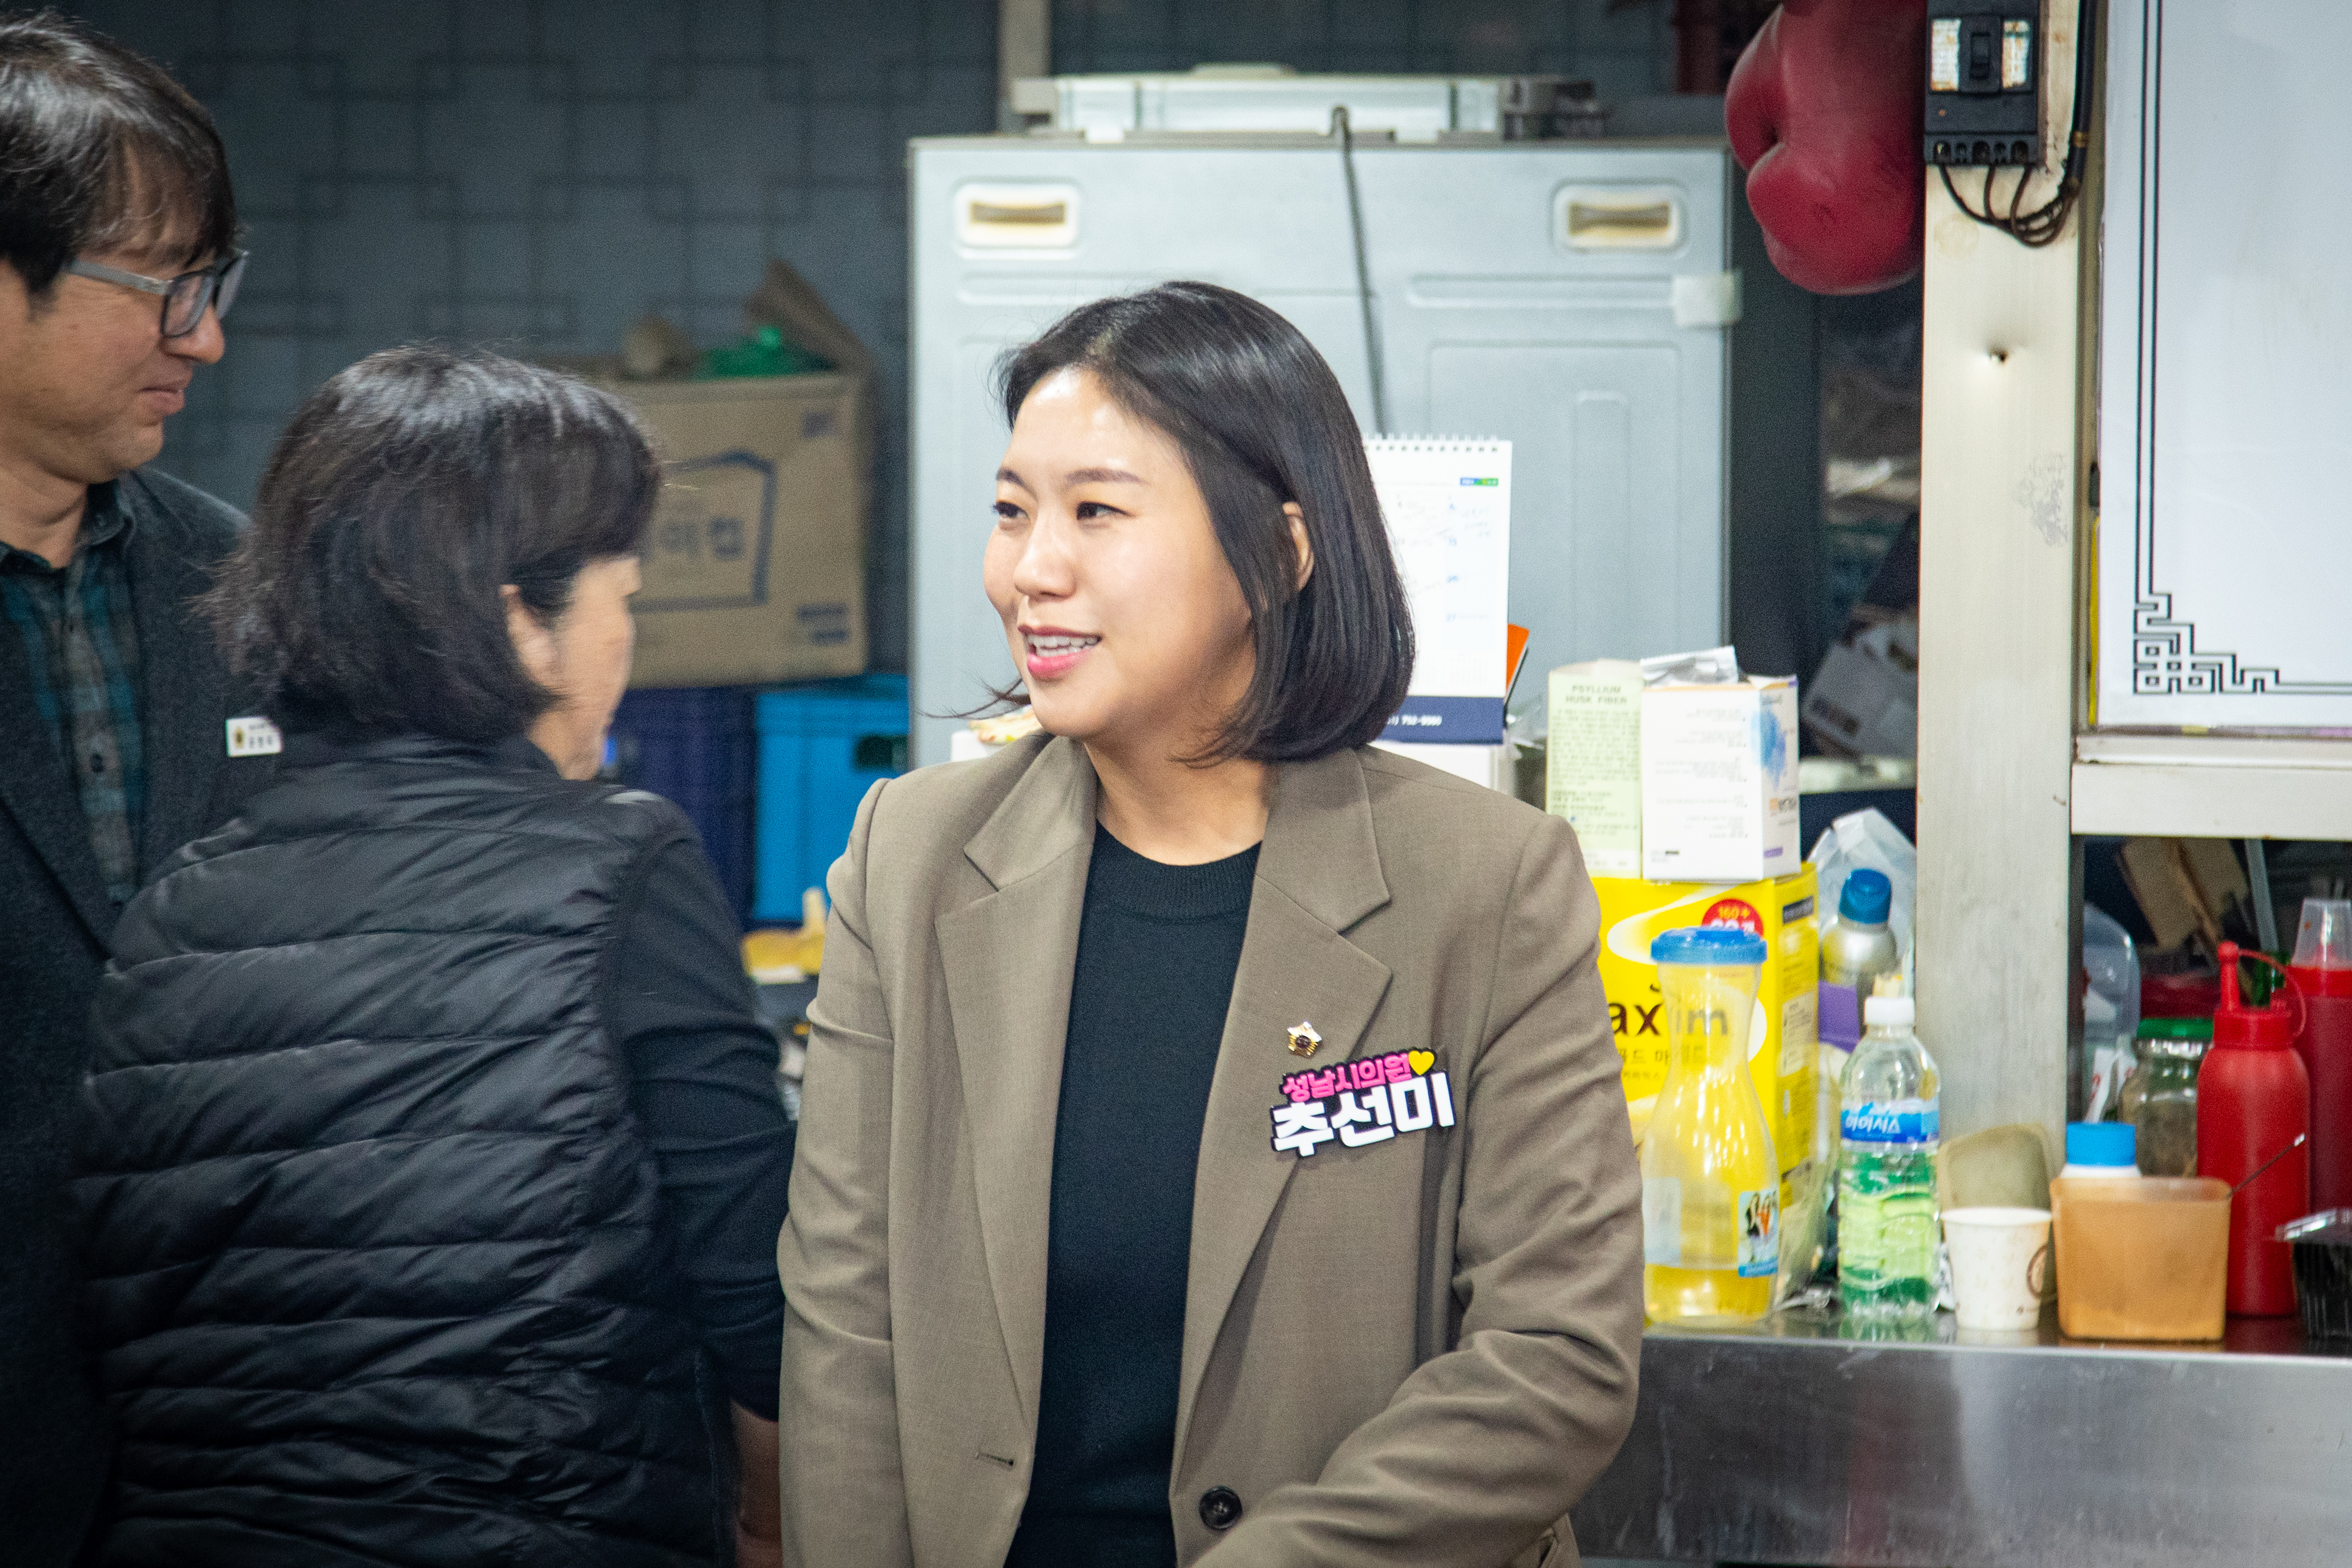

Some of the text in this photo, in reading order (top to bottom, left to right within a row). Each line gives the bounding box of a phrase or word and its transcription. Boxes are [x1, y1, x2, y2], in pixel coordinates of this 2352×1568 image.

[1565, 695, 1627, 705] HUSK FIBER
[1571, 685, 1622, 694] PSYLLIUM
[1283, 1052, 1412, 1102] 성남시의원
[1272, 1072, 1454, 1157] 추선미
